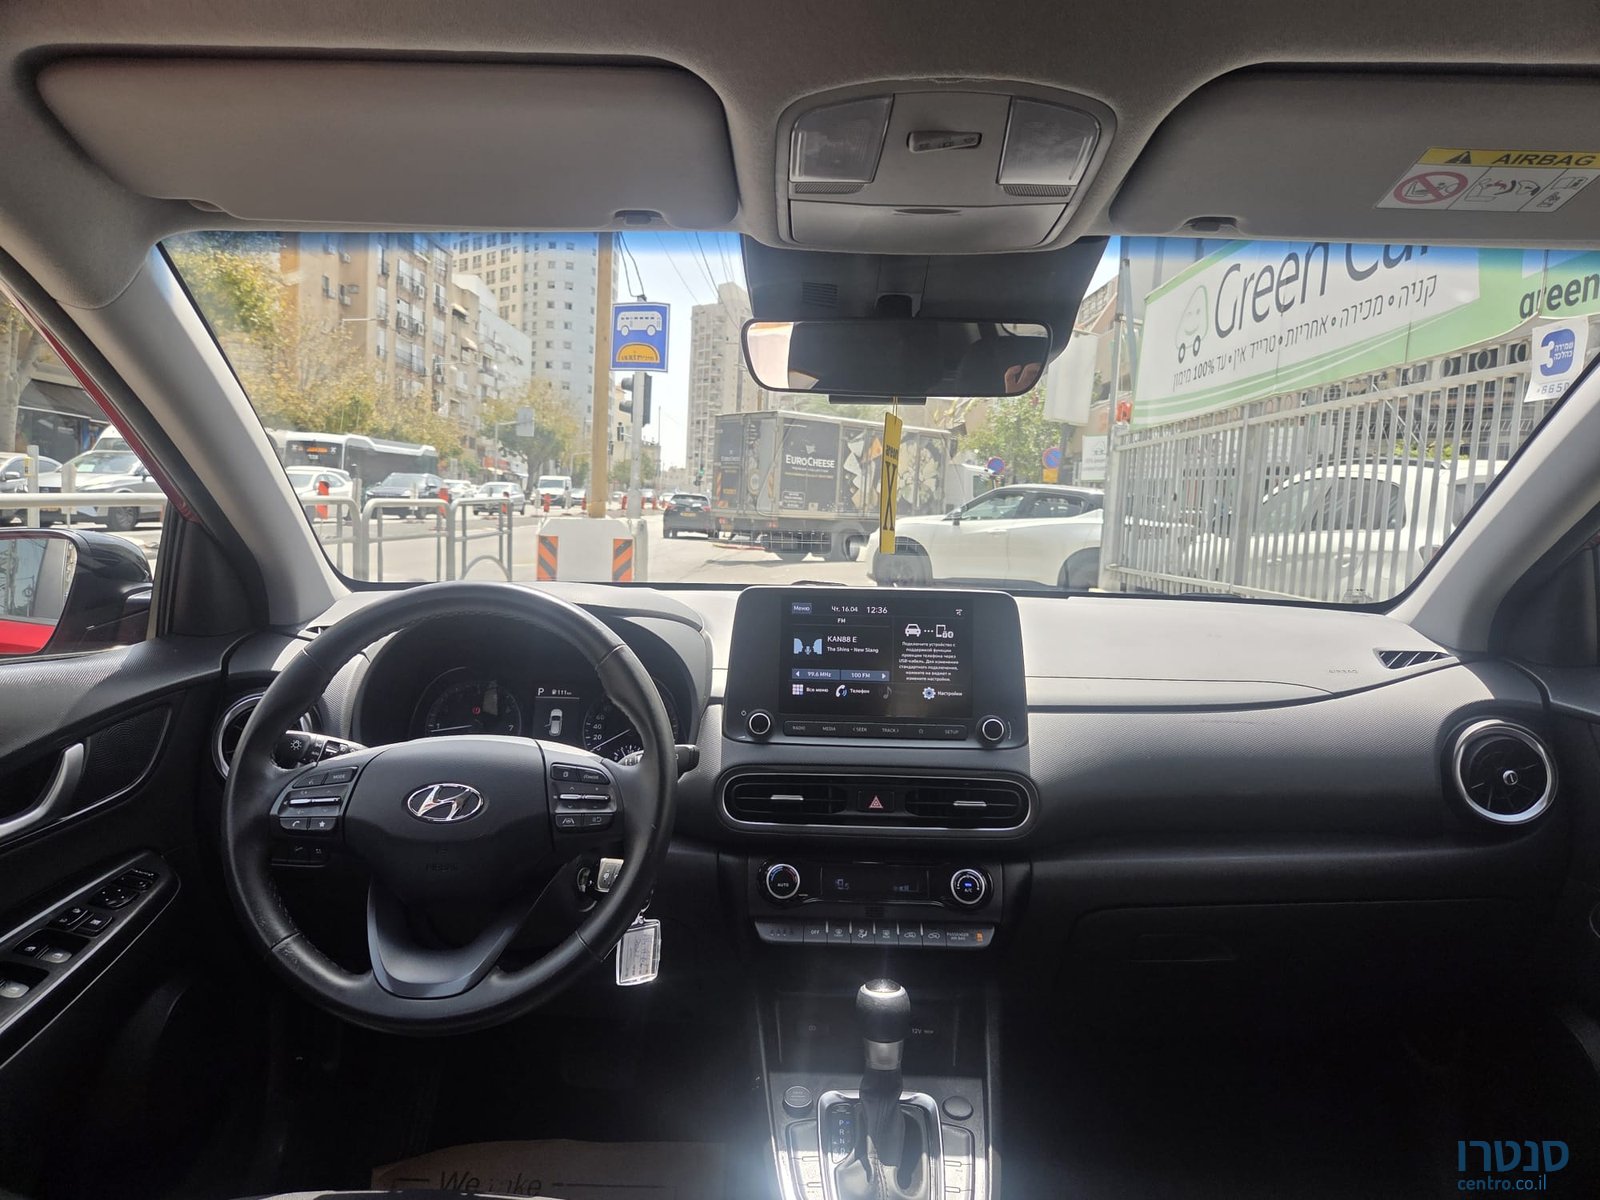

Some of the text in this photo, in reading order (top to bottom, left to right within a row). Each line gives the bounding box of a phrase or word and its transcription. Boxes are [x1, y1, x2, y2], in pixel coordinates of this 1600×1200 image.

[1492, 153, 1597, 167] AIRBAG
[1215, 242, 1329, 338] Green
[1398, 274, 1437, 308] קניה
[1340, 294, 1383, 328] מכירה
[1284, 315, 1328, 347] אחריות
[1250, 335, 1276, 359] טרייד
[1217, 354, 1226, 372] עד
[1233, 346, 1247, 371] אין
[1193, 359, 1215, 380] 100%
[841, 605, 858, 613] 16.04
[866, 606, 888, 614] 12:36
[537, 687, 545, 696] P
[440, 1171, 480, 1191] We
